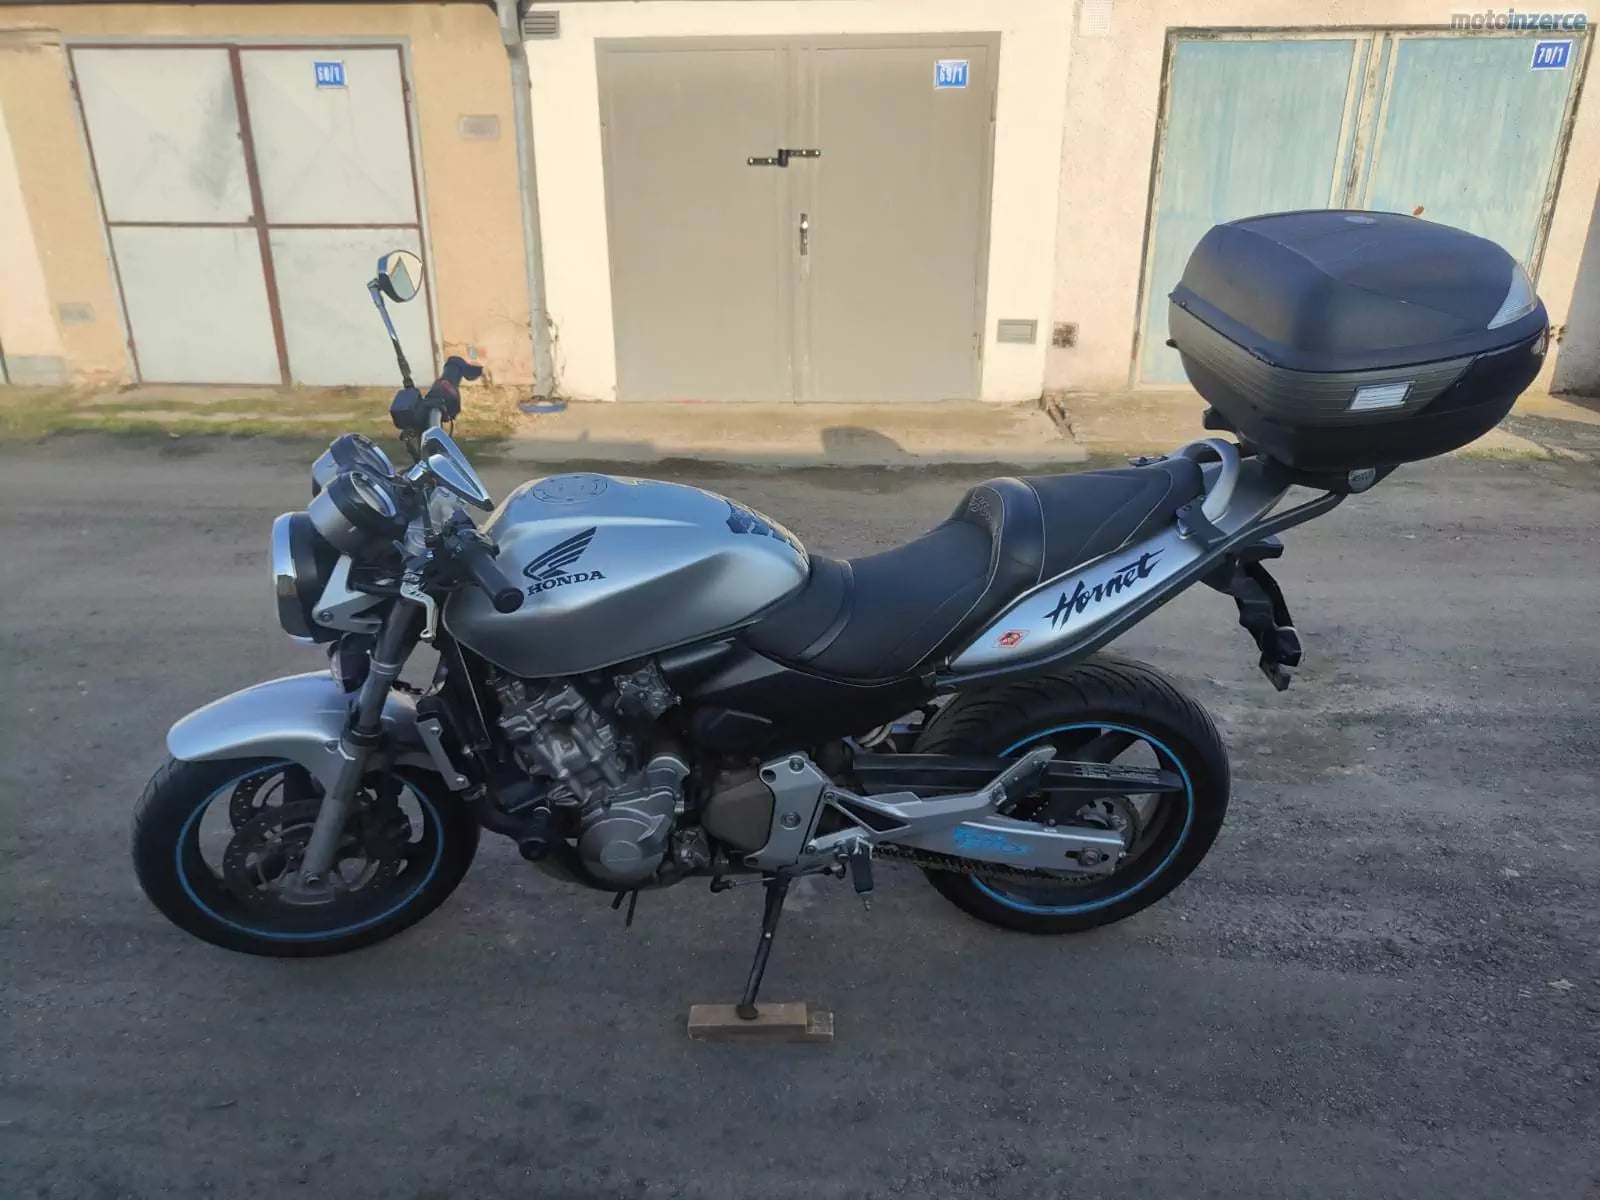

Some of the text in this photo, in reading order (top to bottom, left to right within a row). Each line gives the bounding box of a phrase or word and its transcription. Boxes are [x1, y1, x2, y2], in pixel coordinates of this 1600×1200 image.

[1537, 46, 1564, 65] 70/1
[526, 570, 607, 596] HONDA
[1042, 548, 1166, 631] Hornet
